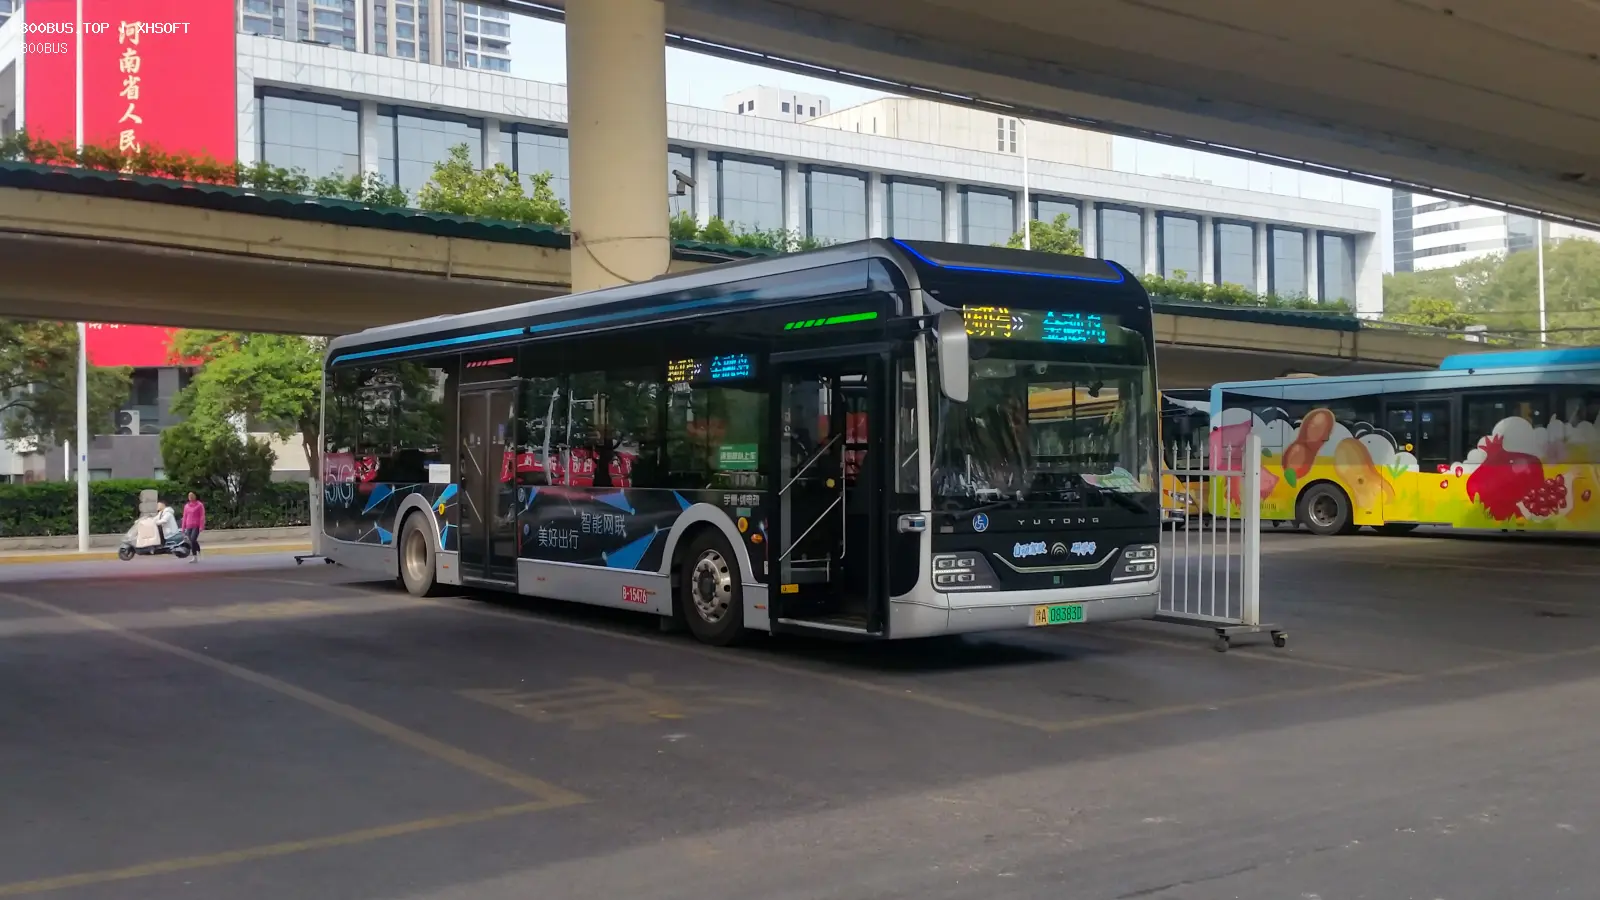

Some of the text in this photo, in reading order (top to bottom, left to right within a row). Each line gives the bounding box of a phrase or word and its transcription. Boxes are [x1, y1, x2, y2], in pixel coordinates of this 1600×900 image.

[581, 511, 627, 536] 智能网联
[1018, 517, 1100, 526] YUTONG
[538, 525, 579, 550] 美好出行
